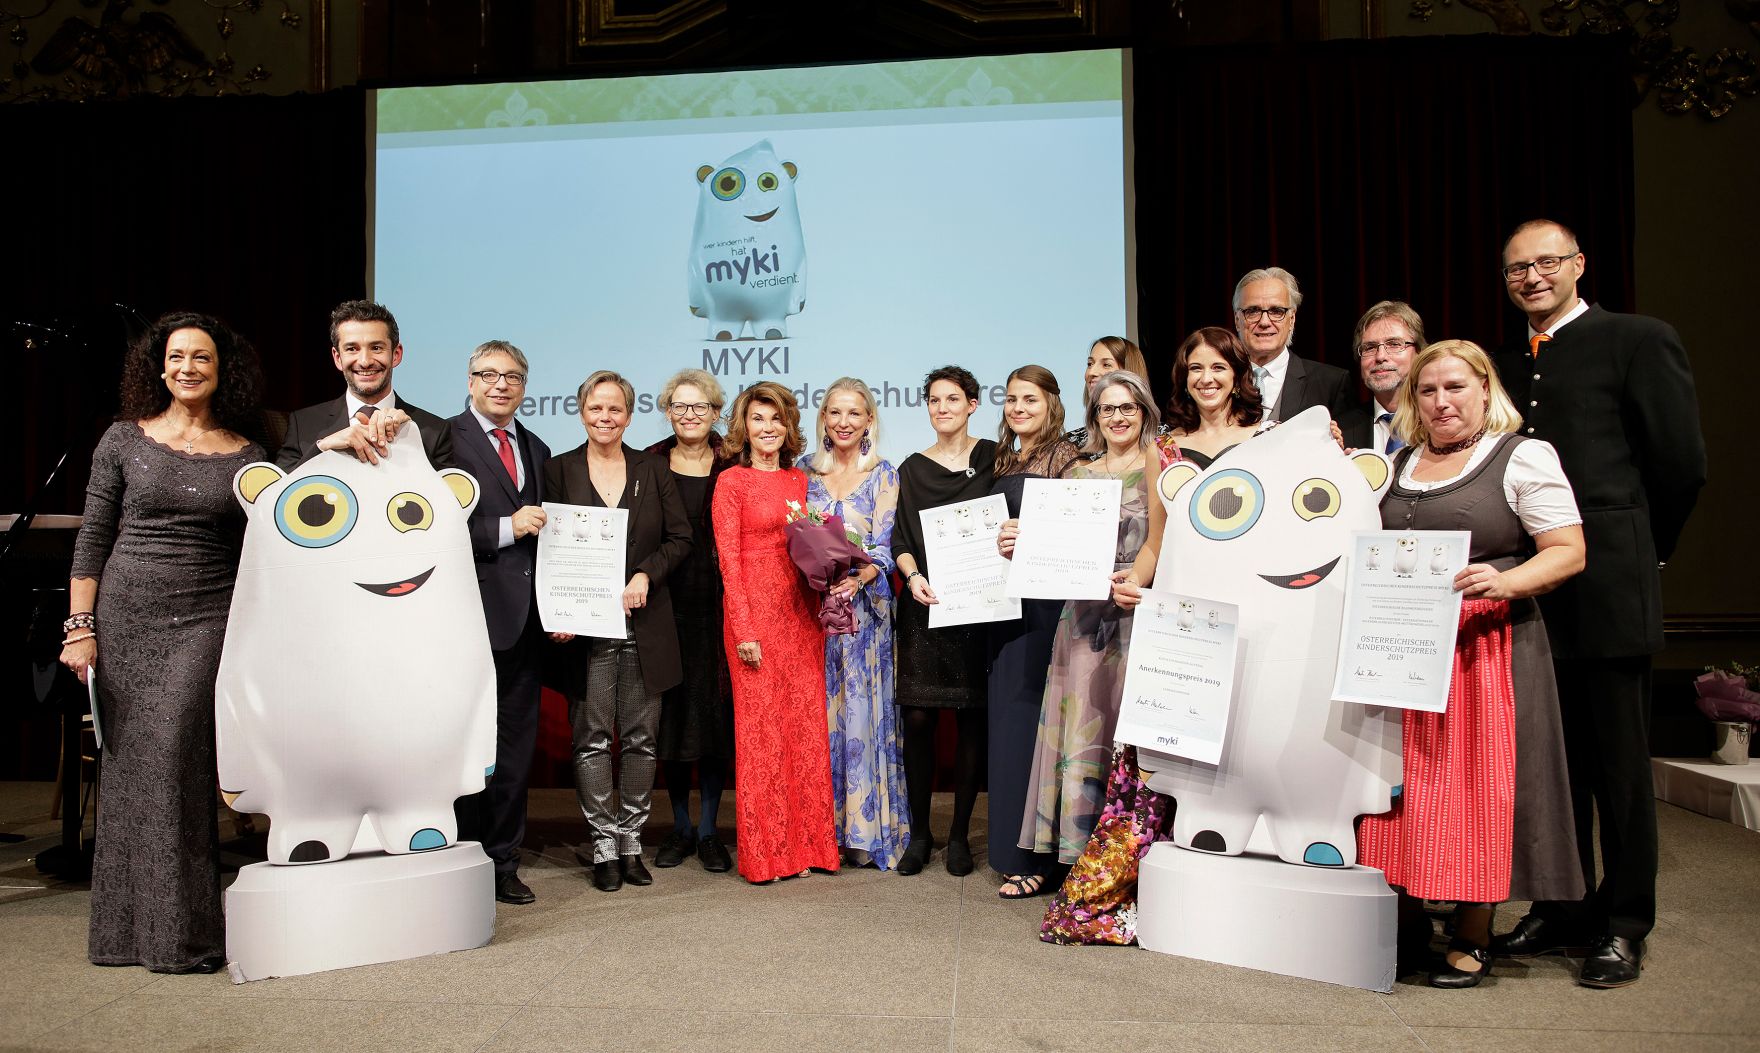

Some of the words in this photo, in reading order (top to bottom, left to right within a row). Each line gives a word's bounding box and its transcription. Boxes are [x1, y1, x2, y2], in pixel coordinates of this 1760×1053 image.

[731, 246, 747, 256] hat
[705, 244, 780, 285] myki
[702, 346, 790, 376] MYKI
[1356, 642, 1438, 656] KINDERSCHUTZPREIS
[1386, 653, 1404, 661] 2019
[1138, 664, 1203, 683] Anerkennungspreis
[1204, 677, 1221, 687] 2019
[1157, 735, 1179, 746] myki
